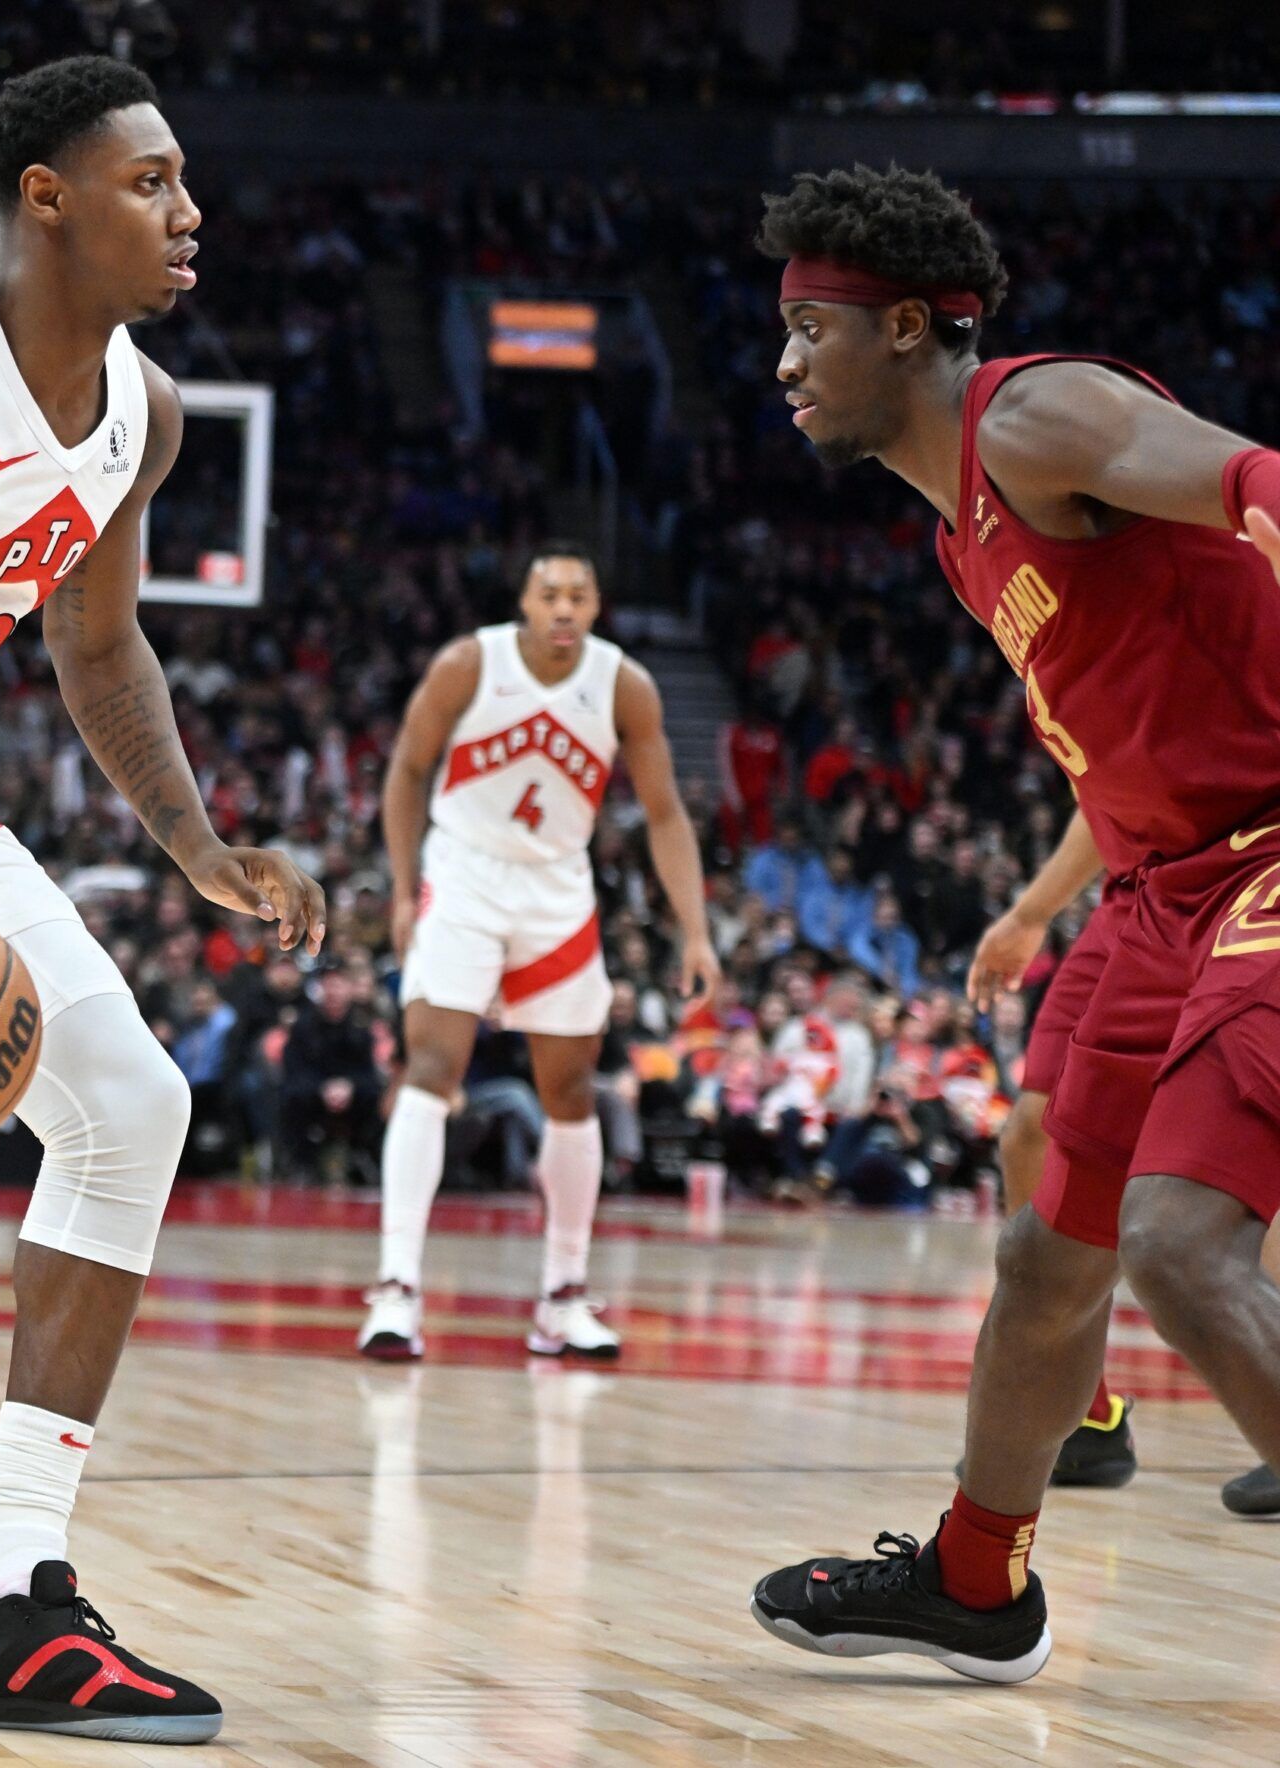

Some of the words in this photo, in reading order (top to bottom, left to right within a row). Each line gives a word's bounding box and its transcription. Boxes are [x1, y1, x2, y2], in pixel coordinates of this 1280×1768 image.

[102, 461, 115, 475] Sun
[116, 458, 130, 473] Life
[977, 513, 999, 545] CLIFFS
[511, 779, 545, 833] 4
